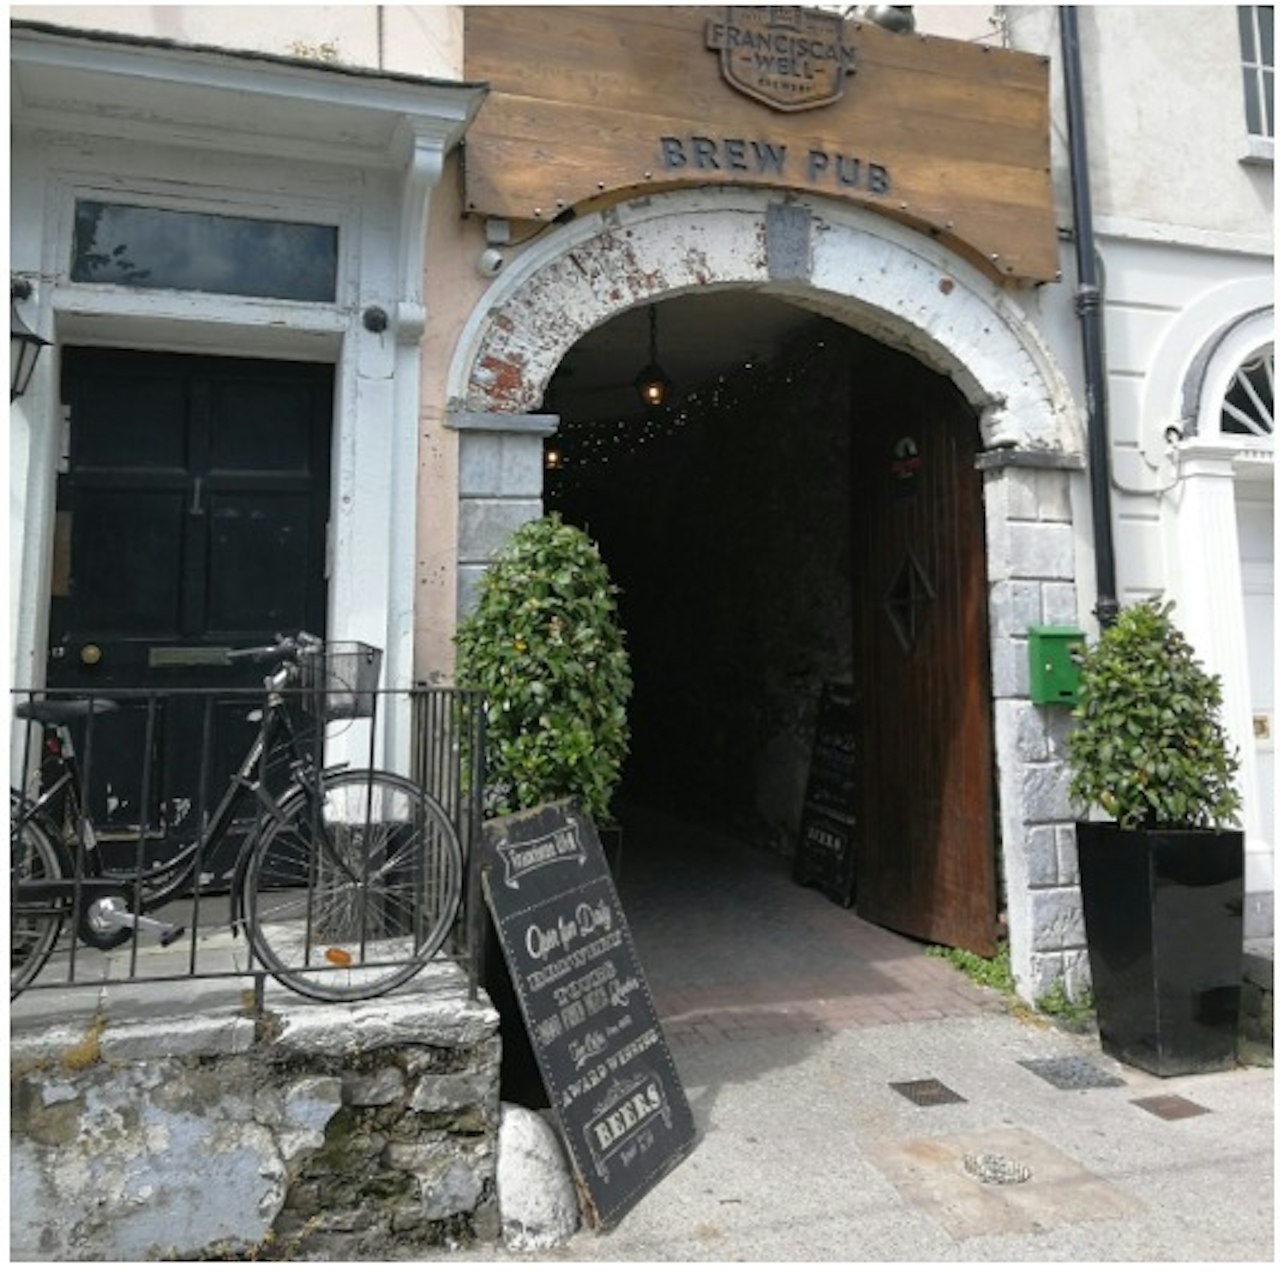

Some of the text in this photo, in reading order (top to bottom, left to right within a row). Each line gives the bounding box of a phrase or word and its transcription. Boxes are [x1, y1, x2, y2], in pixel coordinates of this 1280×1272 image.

[712, 23, 856, 62] FRANCISCAN
[755, 53, 814, 79] WELL
[660, 137, 892, 196] BREW PUB
[525, 924, 560, 961] Open
[561, 1063, 608, 1108] AWARD
[594, 1082, 662, 1150] BEERS
